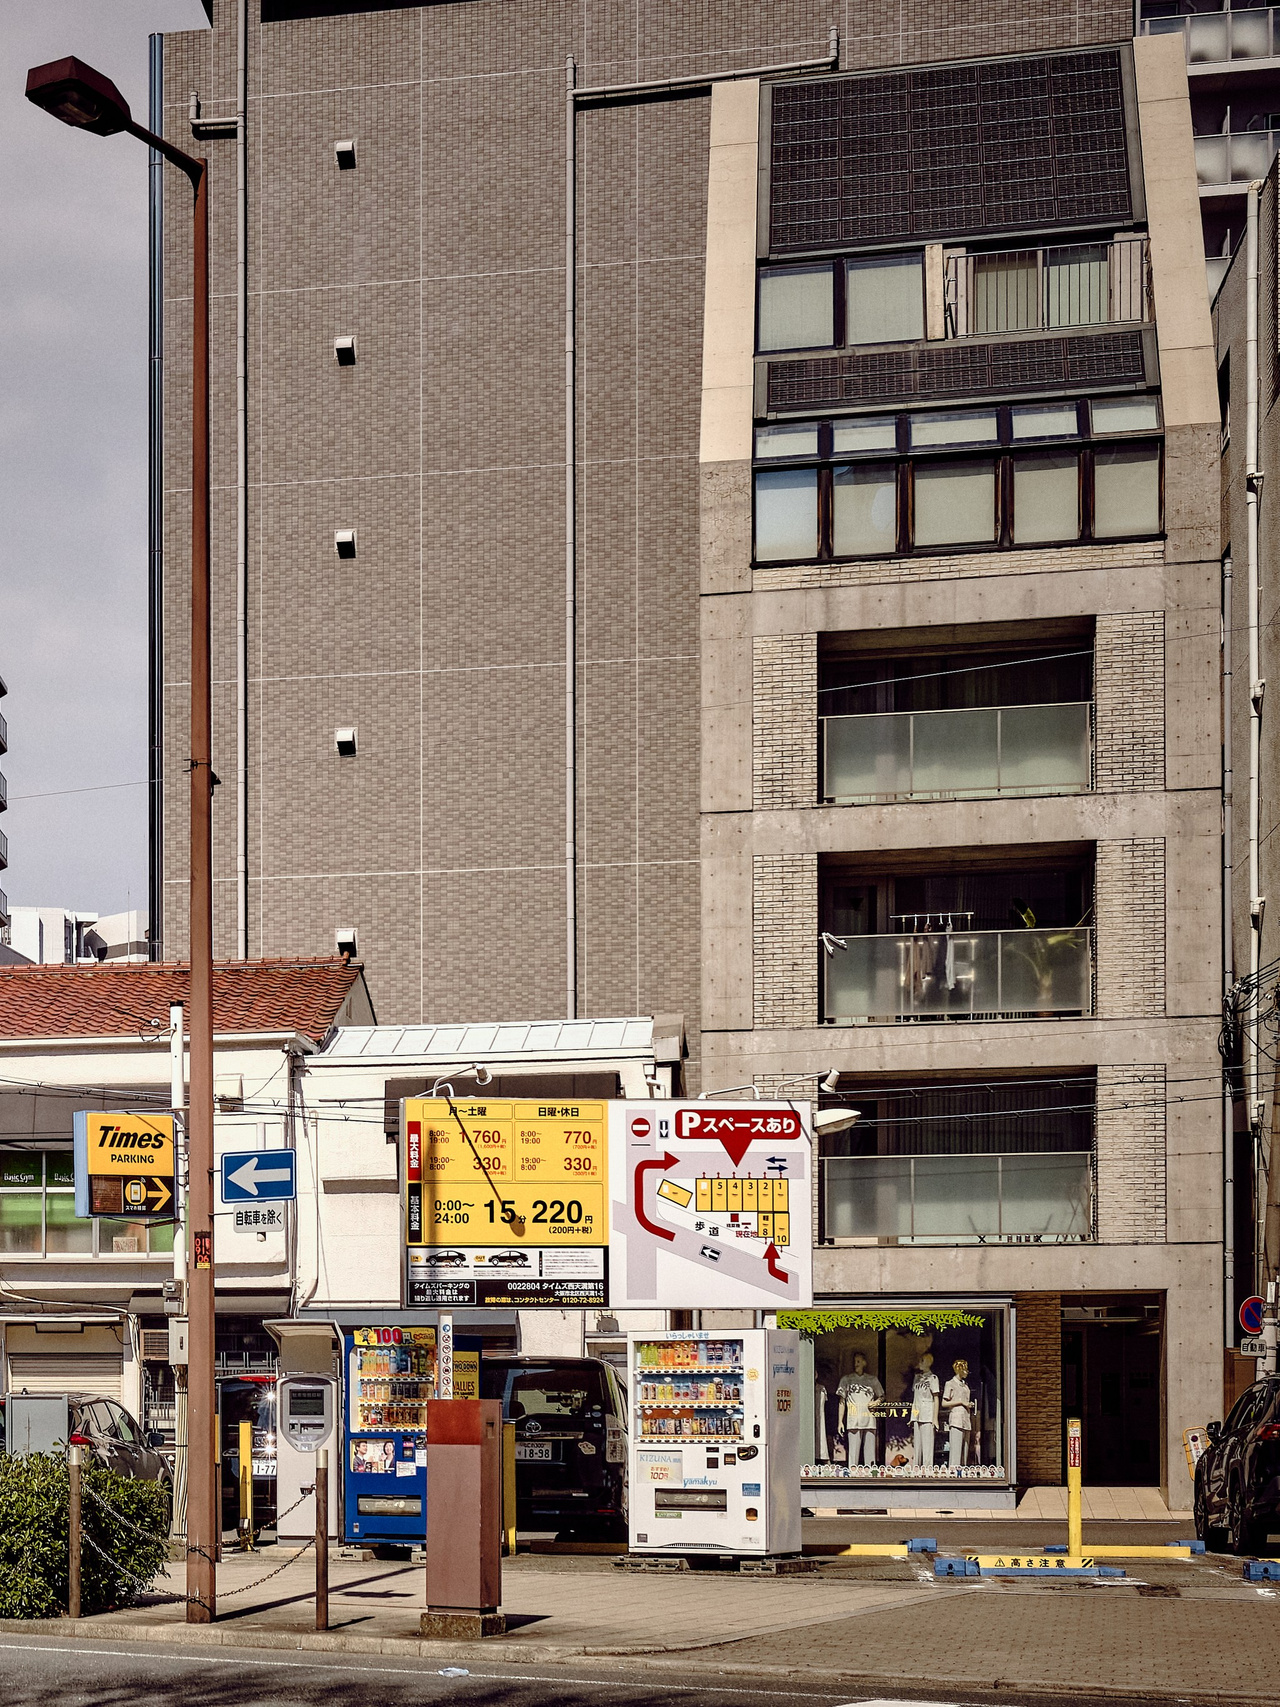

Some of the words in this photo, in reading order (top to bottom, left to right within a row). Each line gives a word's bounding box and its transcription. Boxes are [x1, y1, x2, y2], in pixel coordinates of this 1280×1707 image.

[538, 1107, 580, 1117] 日曜・休日
[98, 1126, 166, 1149] Times
[410, 1134, 420, 1169] 最大料金
[111, 1154, 154, 1164] PARKING
[19, 1172, 34, 1182] Gym
[717, 1182, 723, 1190] 5
[732, 1182, 738, 1190] 4
[747, 1182, 754, 1190] 3
[762, 1182, 768, 1190] 2
[236, 1211, 282, 1226] 自転車を除く
[434, 1213, 469, 1224] 24:00
[762, 1228, 768, 1236] 8
[777, 1235, 787, 1243] 10
[524, 1449, 550, 1458] 18-98
[639, 1454, 672, 1463] KIZUNA
[1011, 1558, 1066, 1568] 高さ注意
